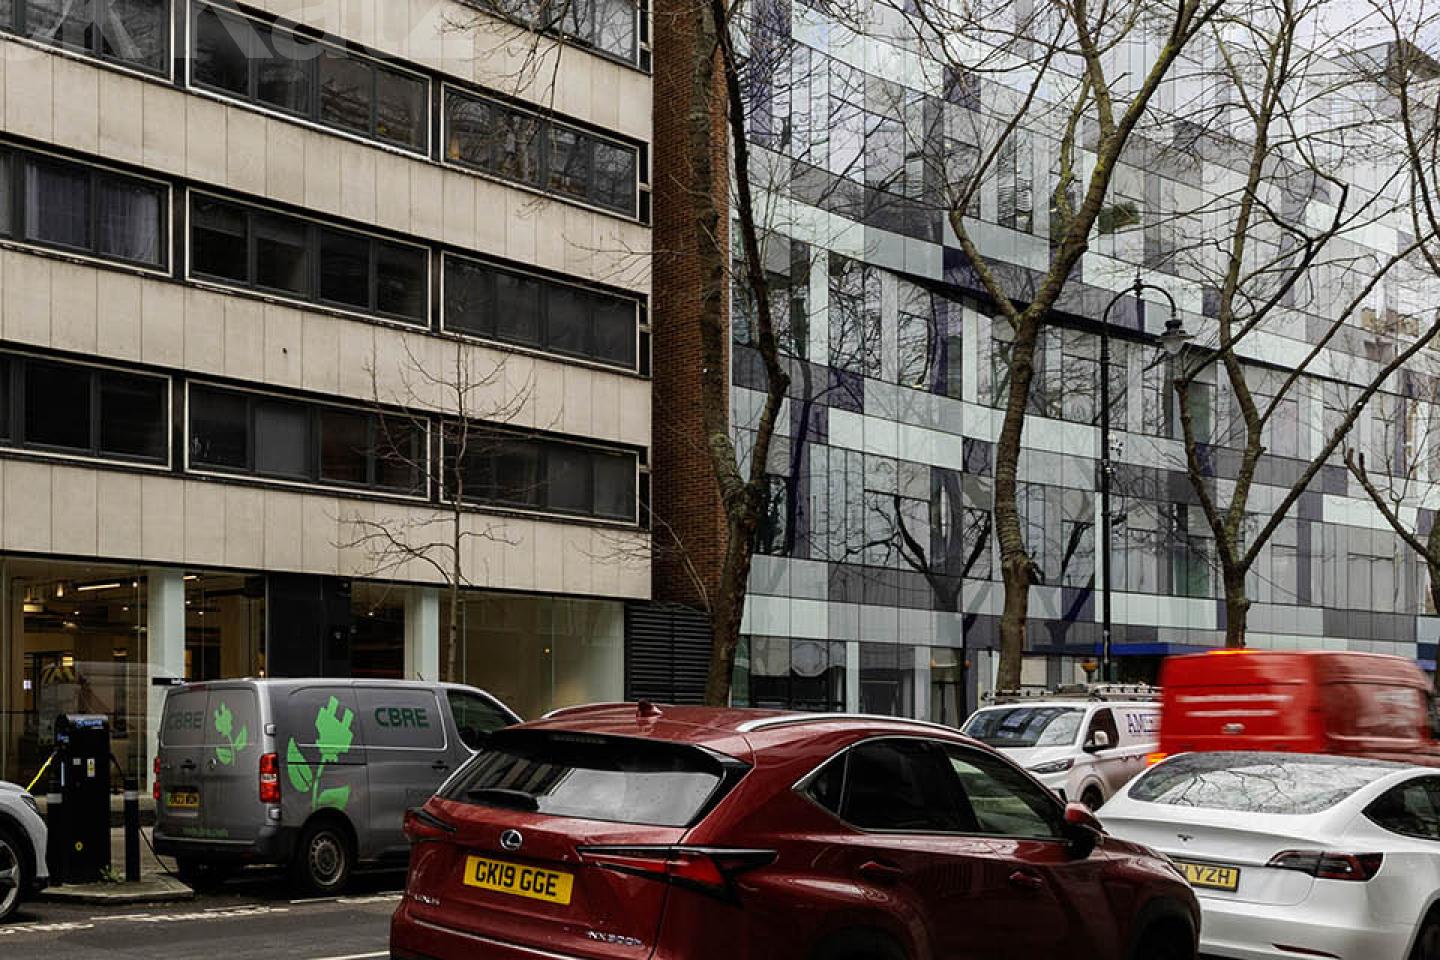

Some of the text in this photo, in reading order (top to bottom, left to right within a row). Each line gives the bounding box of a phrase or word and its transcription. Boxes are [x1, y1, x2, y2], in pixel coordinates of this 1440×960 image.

[166, 710, 205, 730] CBRE
[374, 707, 430, 728] CBRE
[475, 861, 559, 897] GK19 GGE
[1194, 865, 1230, 885] YZH
